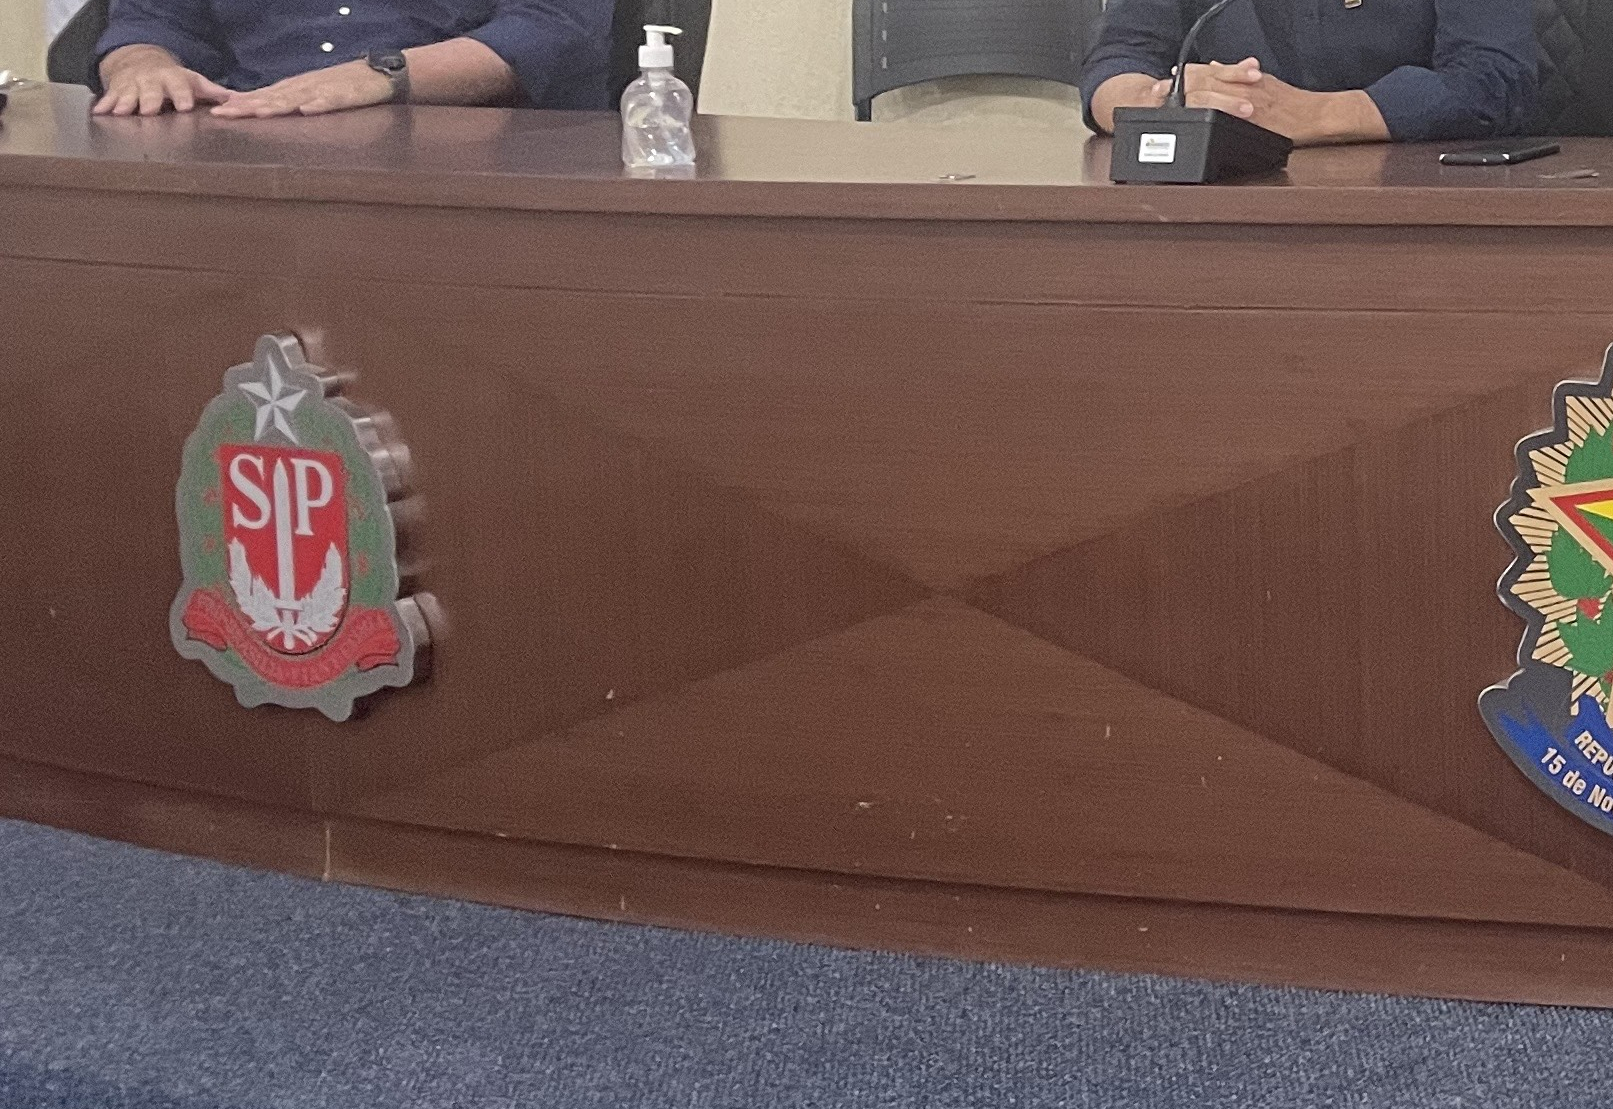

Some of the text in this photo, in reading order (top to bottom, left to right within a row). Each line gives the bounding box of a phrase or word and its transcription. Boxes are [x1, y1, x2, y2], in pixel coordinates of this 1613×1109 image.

[229, 454, 333, 536] SP
[1541, 747, 1567, 775] 15
[1562, 769, 1587, 795] de
